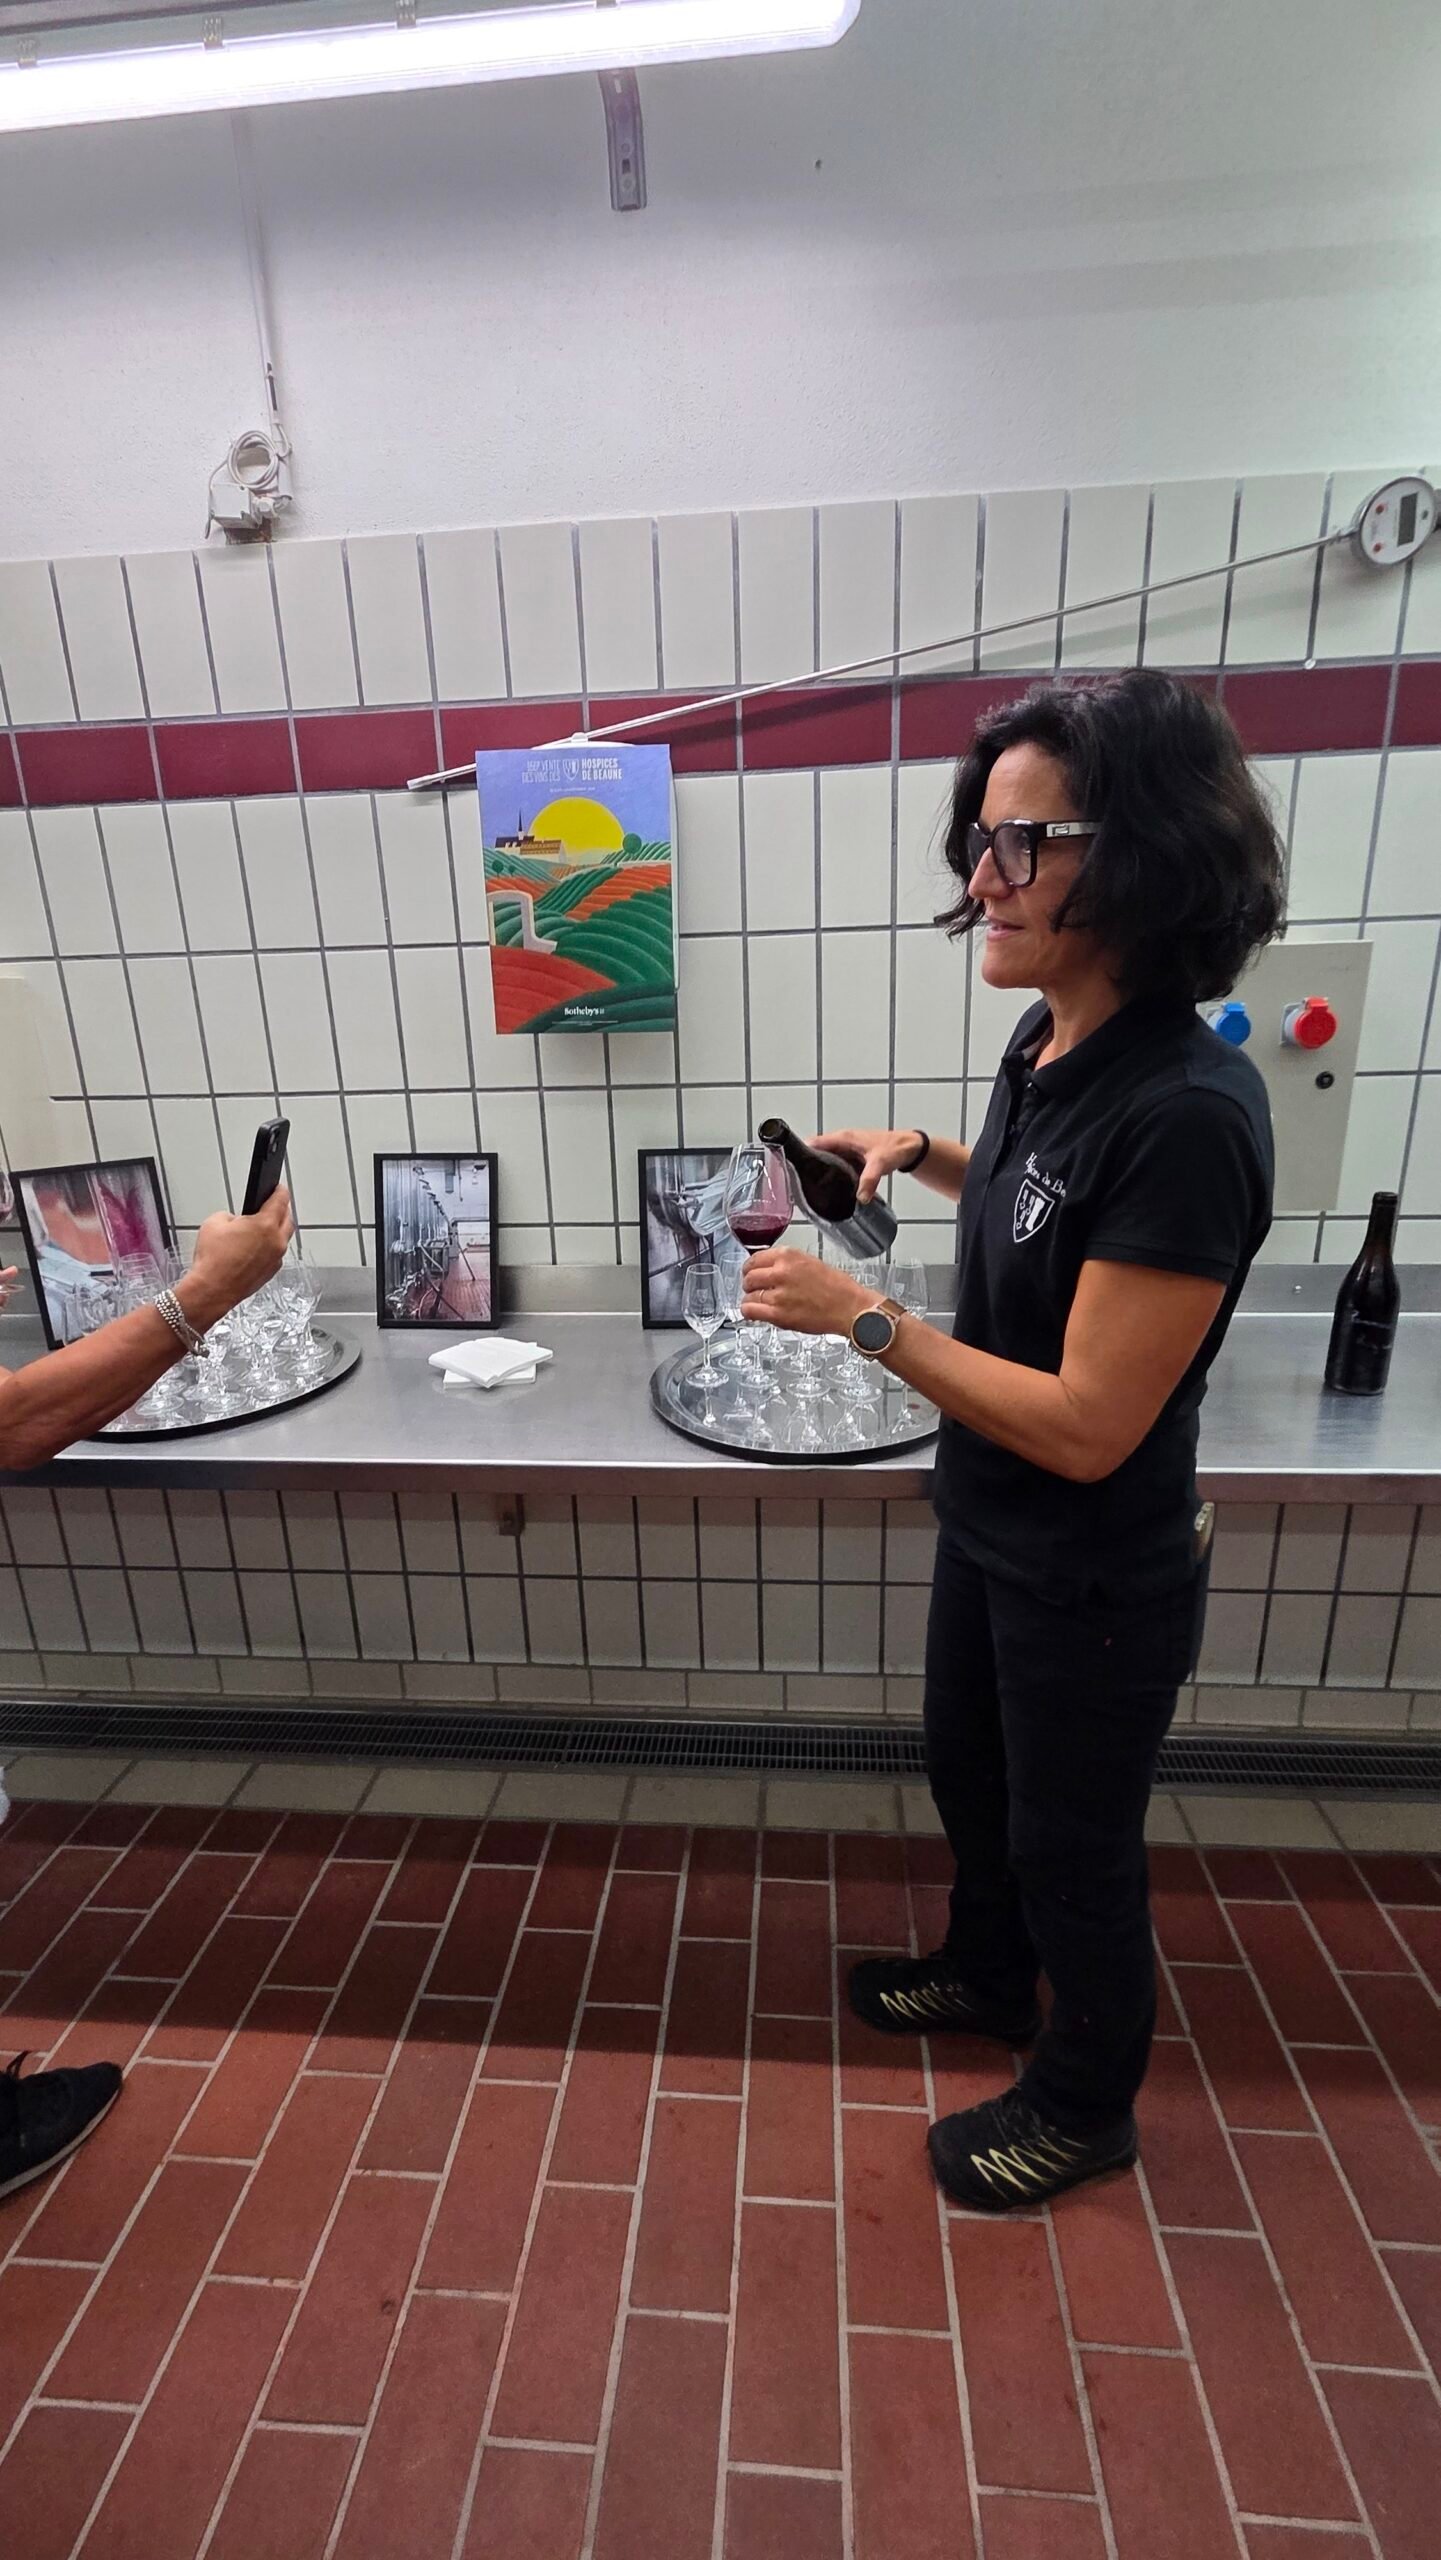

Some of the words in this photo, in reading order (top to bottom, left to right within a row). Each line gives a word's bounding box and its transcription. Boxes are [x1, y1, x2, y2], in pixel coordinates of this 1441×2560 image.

[581, 757, 618, 769] HOSPICES
[582, 769, 592, 781] DE
[593, 768, 622, 780] BEAUNE
[564, 1006, 599, 1017] Sotheby's
